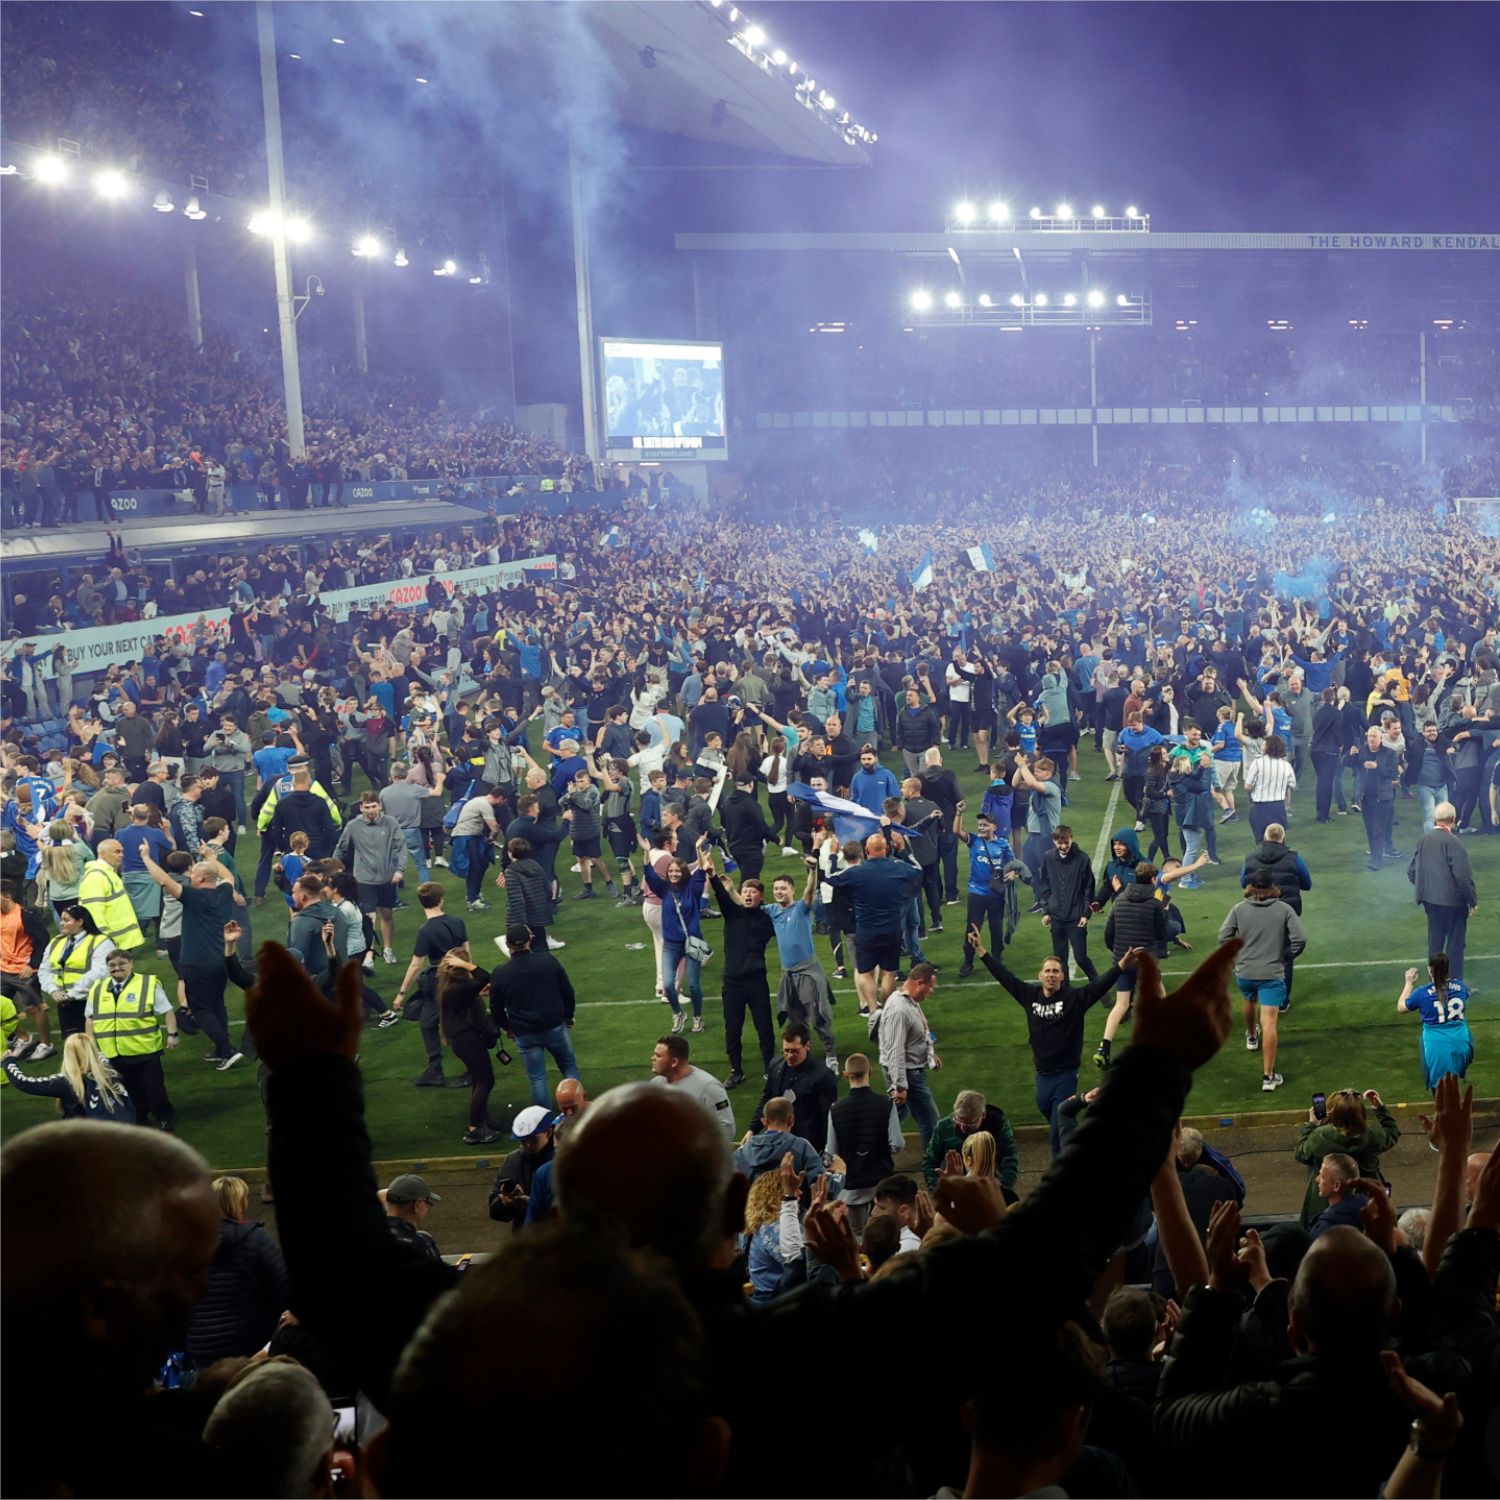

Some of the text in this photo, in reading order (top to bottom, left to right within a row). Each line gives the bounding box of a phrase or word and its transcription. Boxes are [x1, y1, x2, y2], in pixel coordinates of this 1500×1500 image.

[1308, 235, 1340, 248] THE
[1349, 235, 1424, 249] HOWARD
[353, 487, 374, 498] CAZOO
[389, 585, 422, 603] CAZOO
[67, 646, 86, 661] BUY
[88, 640, 115, 658] YOUR
[116, 637, 139, 654] NEXT
[1433, 997, 1465, 1024] 18
